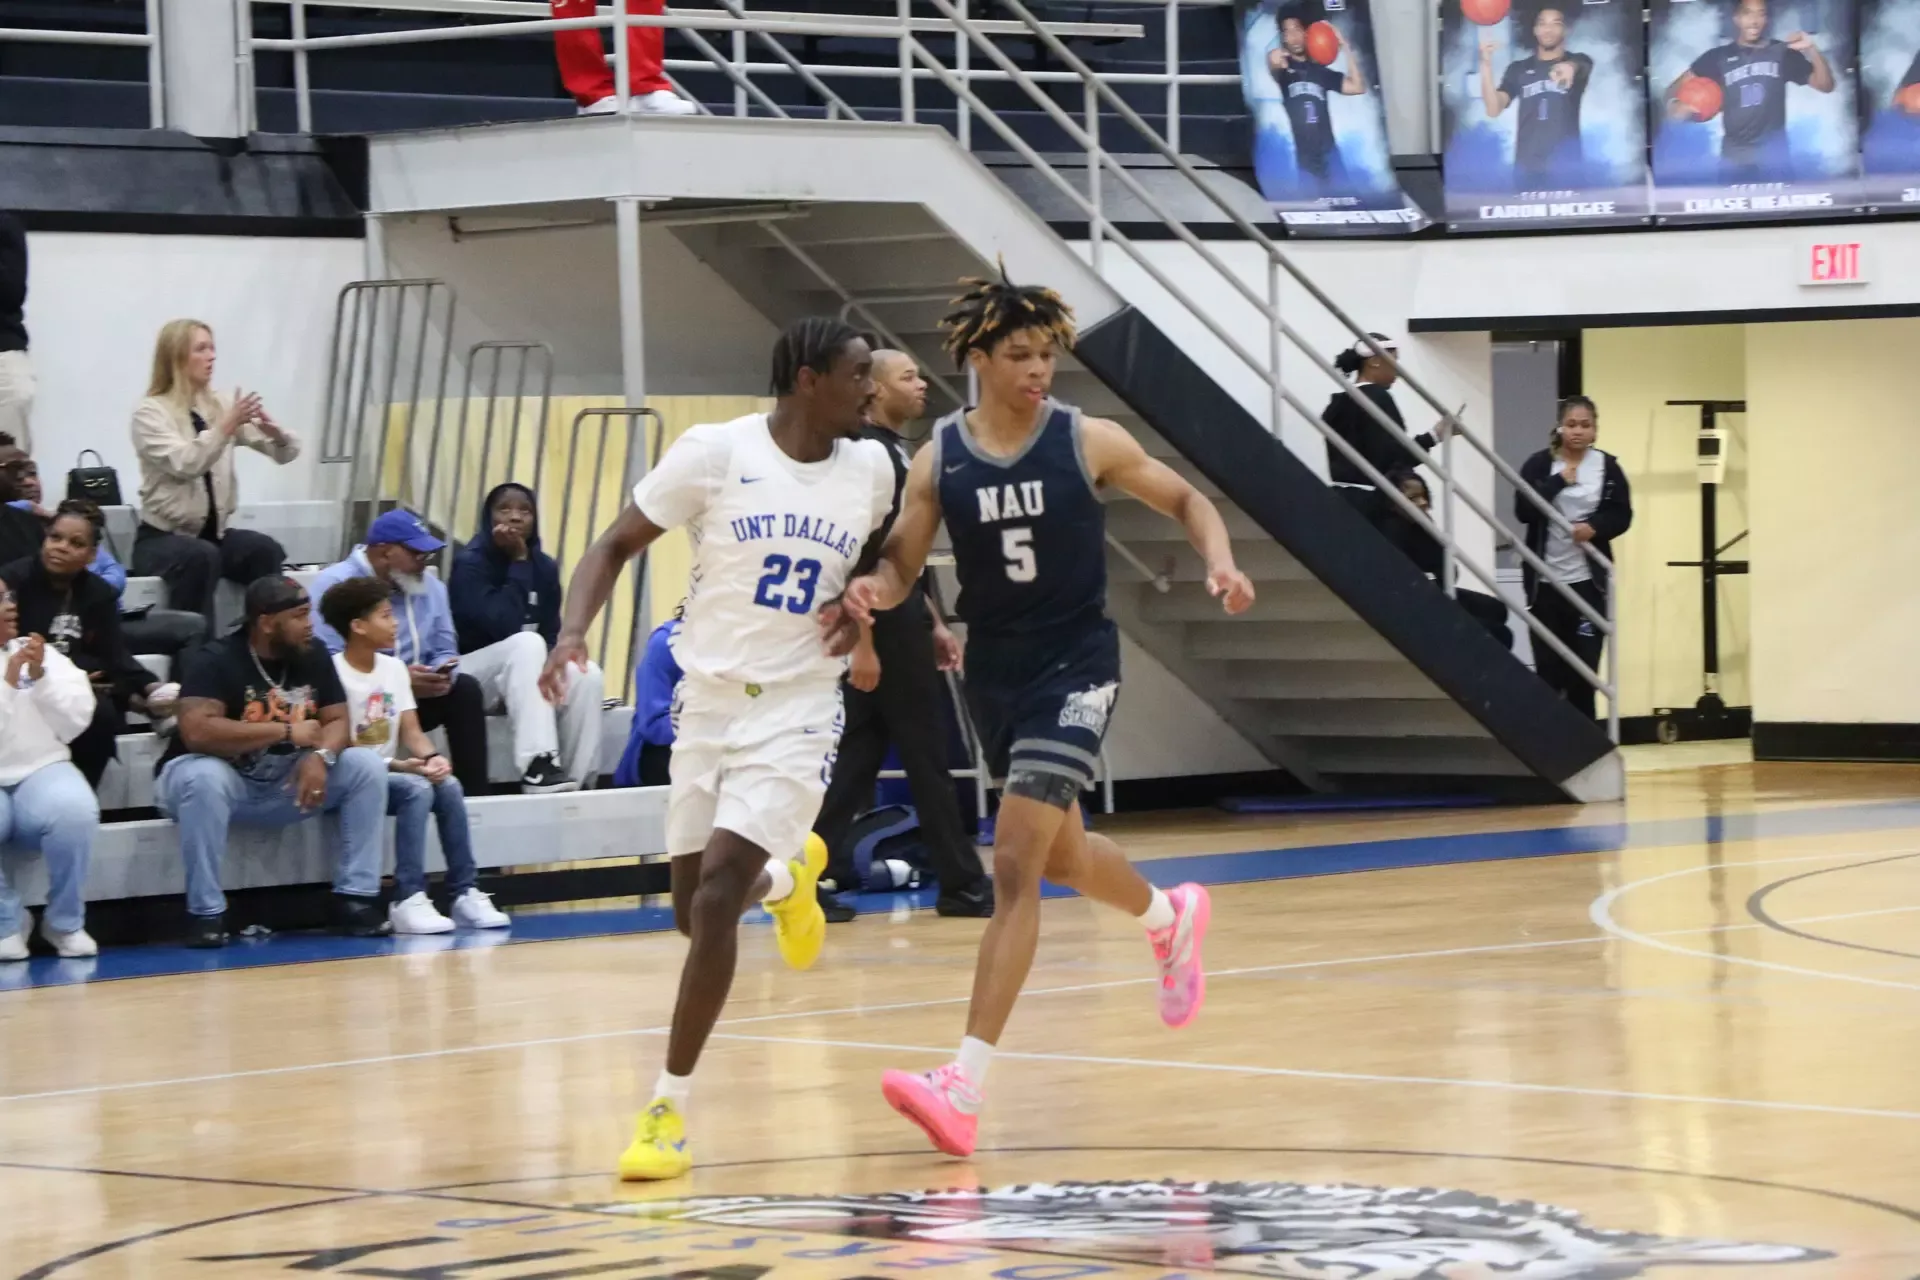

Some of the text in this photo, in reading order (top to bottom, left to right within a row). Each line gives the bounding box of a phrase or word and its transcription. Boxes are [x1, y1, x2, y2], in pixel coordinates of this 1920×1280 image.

[1811, 243, 1863, 280] EXIT
[976, 480, 1045, 523] NAU
[730, 513, 858, 559] UNT DALLAS
[1001, 526, 1038, 583] 5
[753, 553, 822, 615] 23
